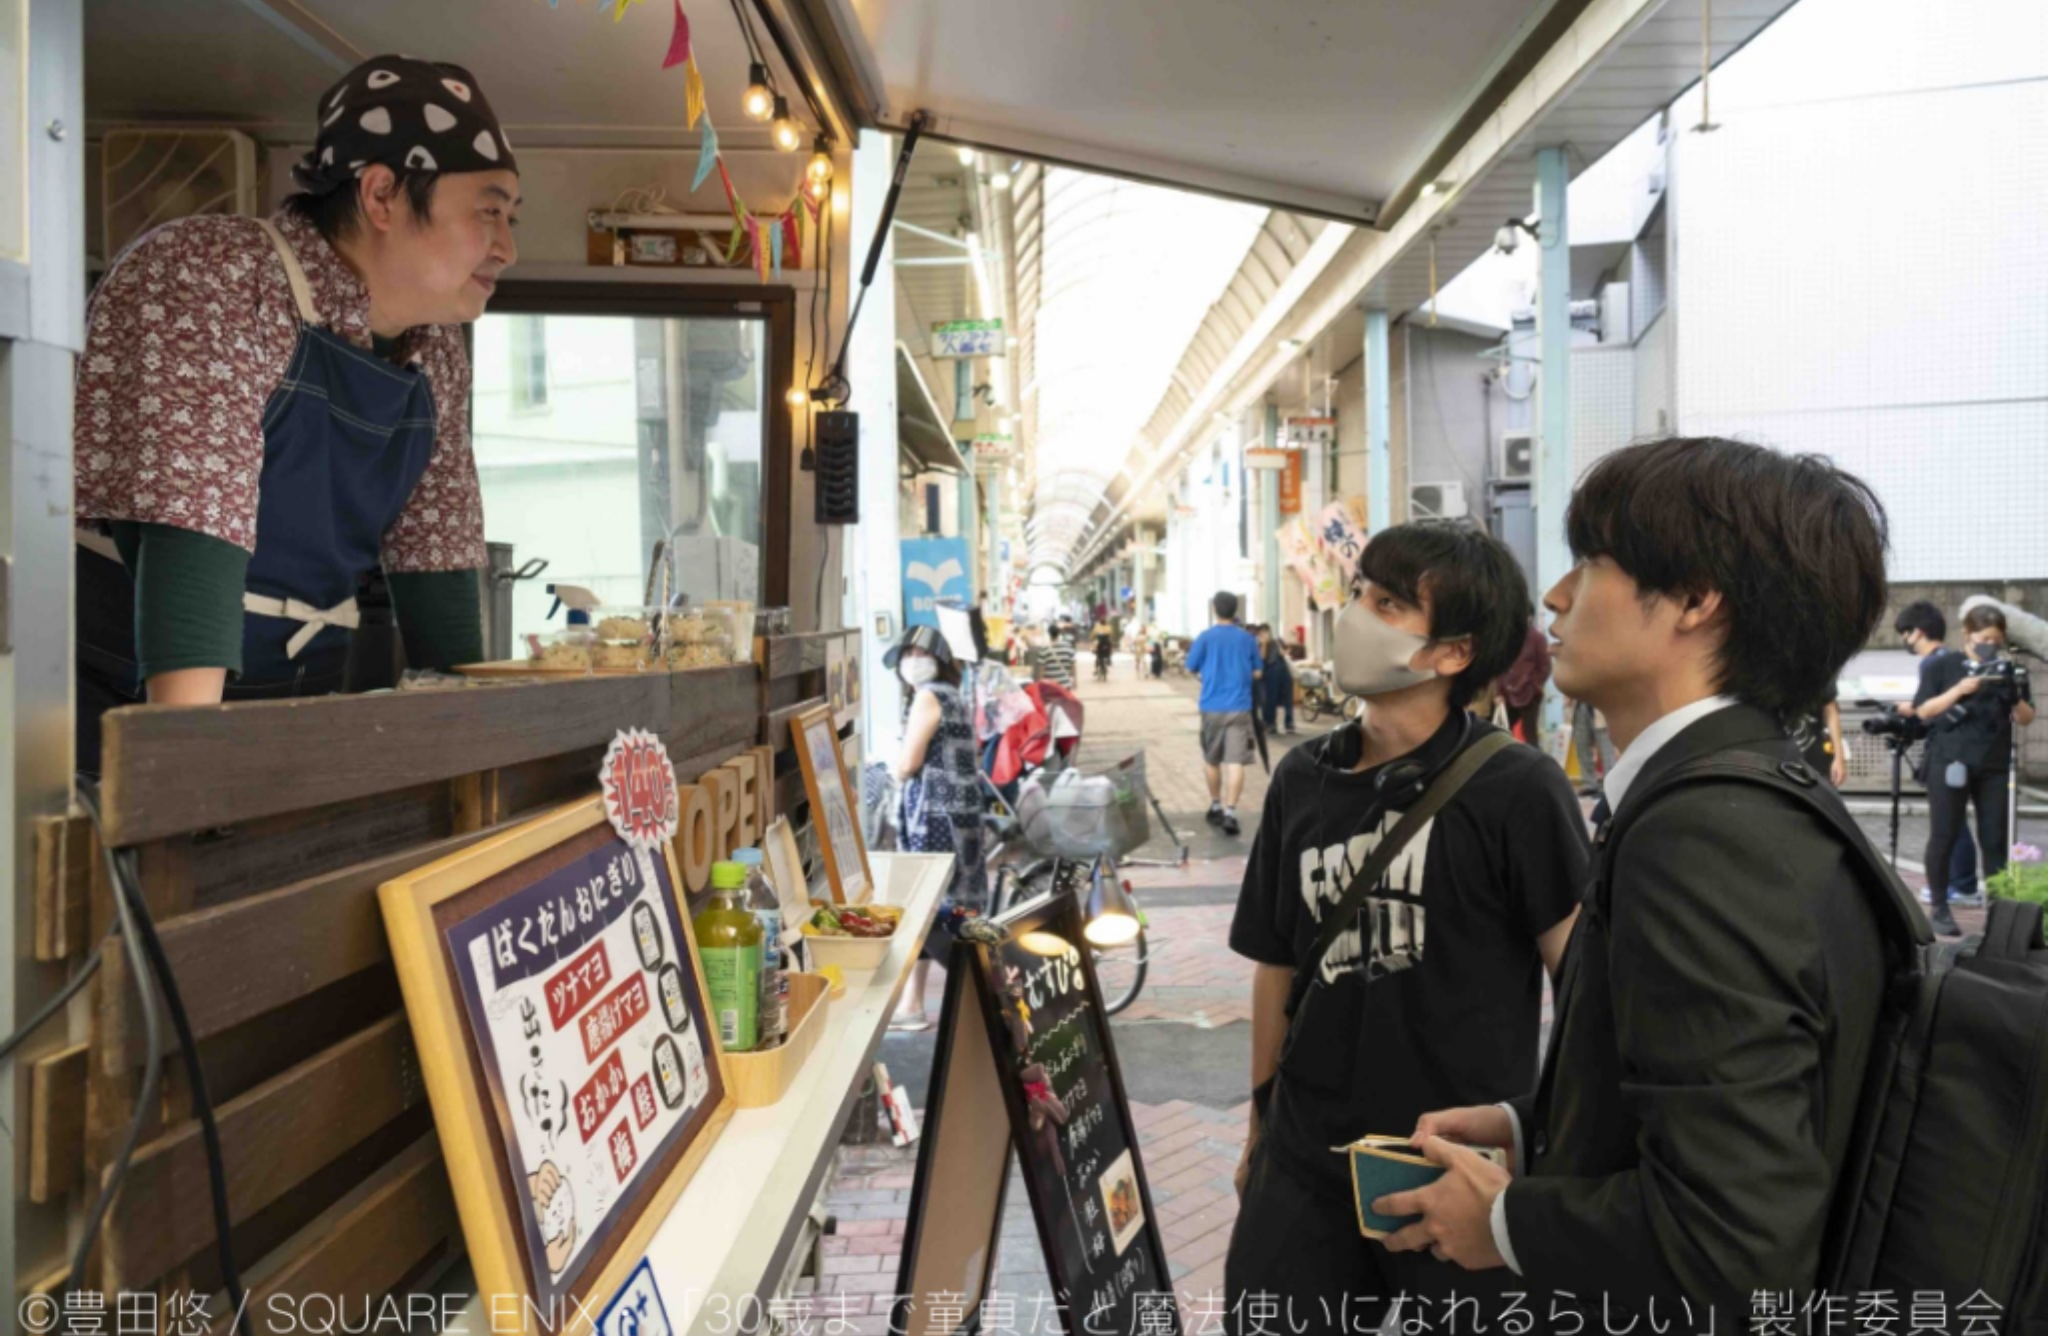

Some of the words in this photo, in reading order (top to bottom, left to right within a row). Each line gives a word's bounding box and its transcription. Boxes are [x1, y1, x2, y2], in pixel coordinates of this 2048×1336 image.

[682, 745, 775, 893] OPEN
[491, 851, 637, 968] ばくだんおにぎり
[551, 953, 606, 1018] ツナマヨ
[585, 981, 645, 1054] 唐揚げマヨ
[579, 1061, 627, 1132] おかか
